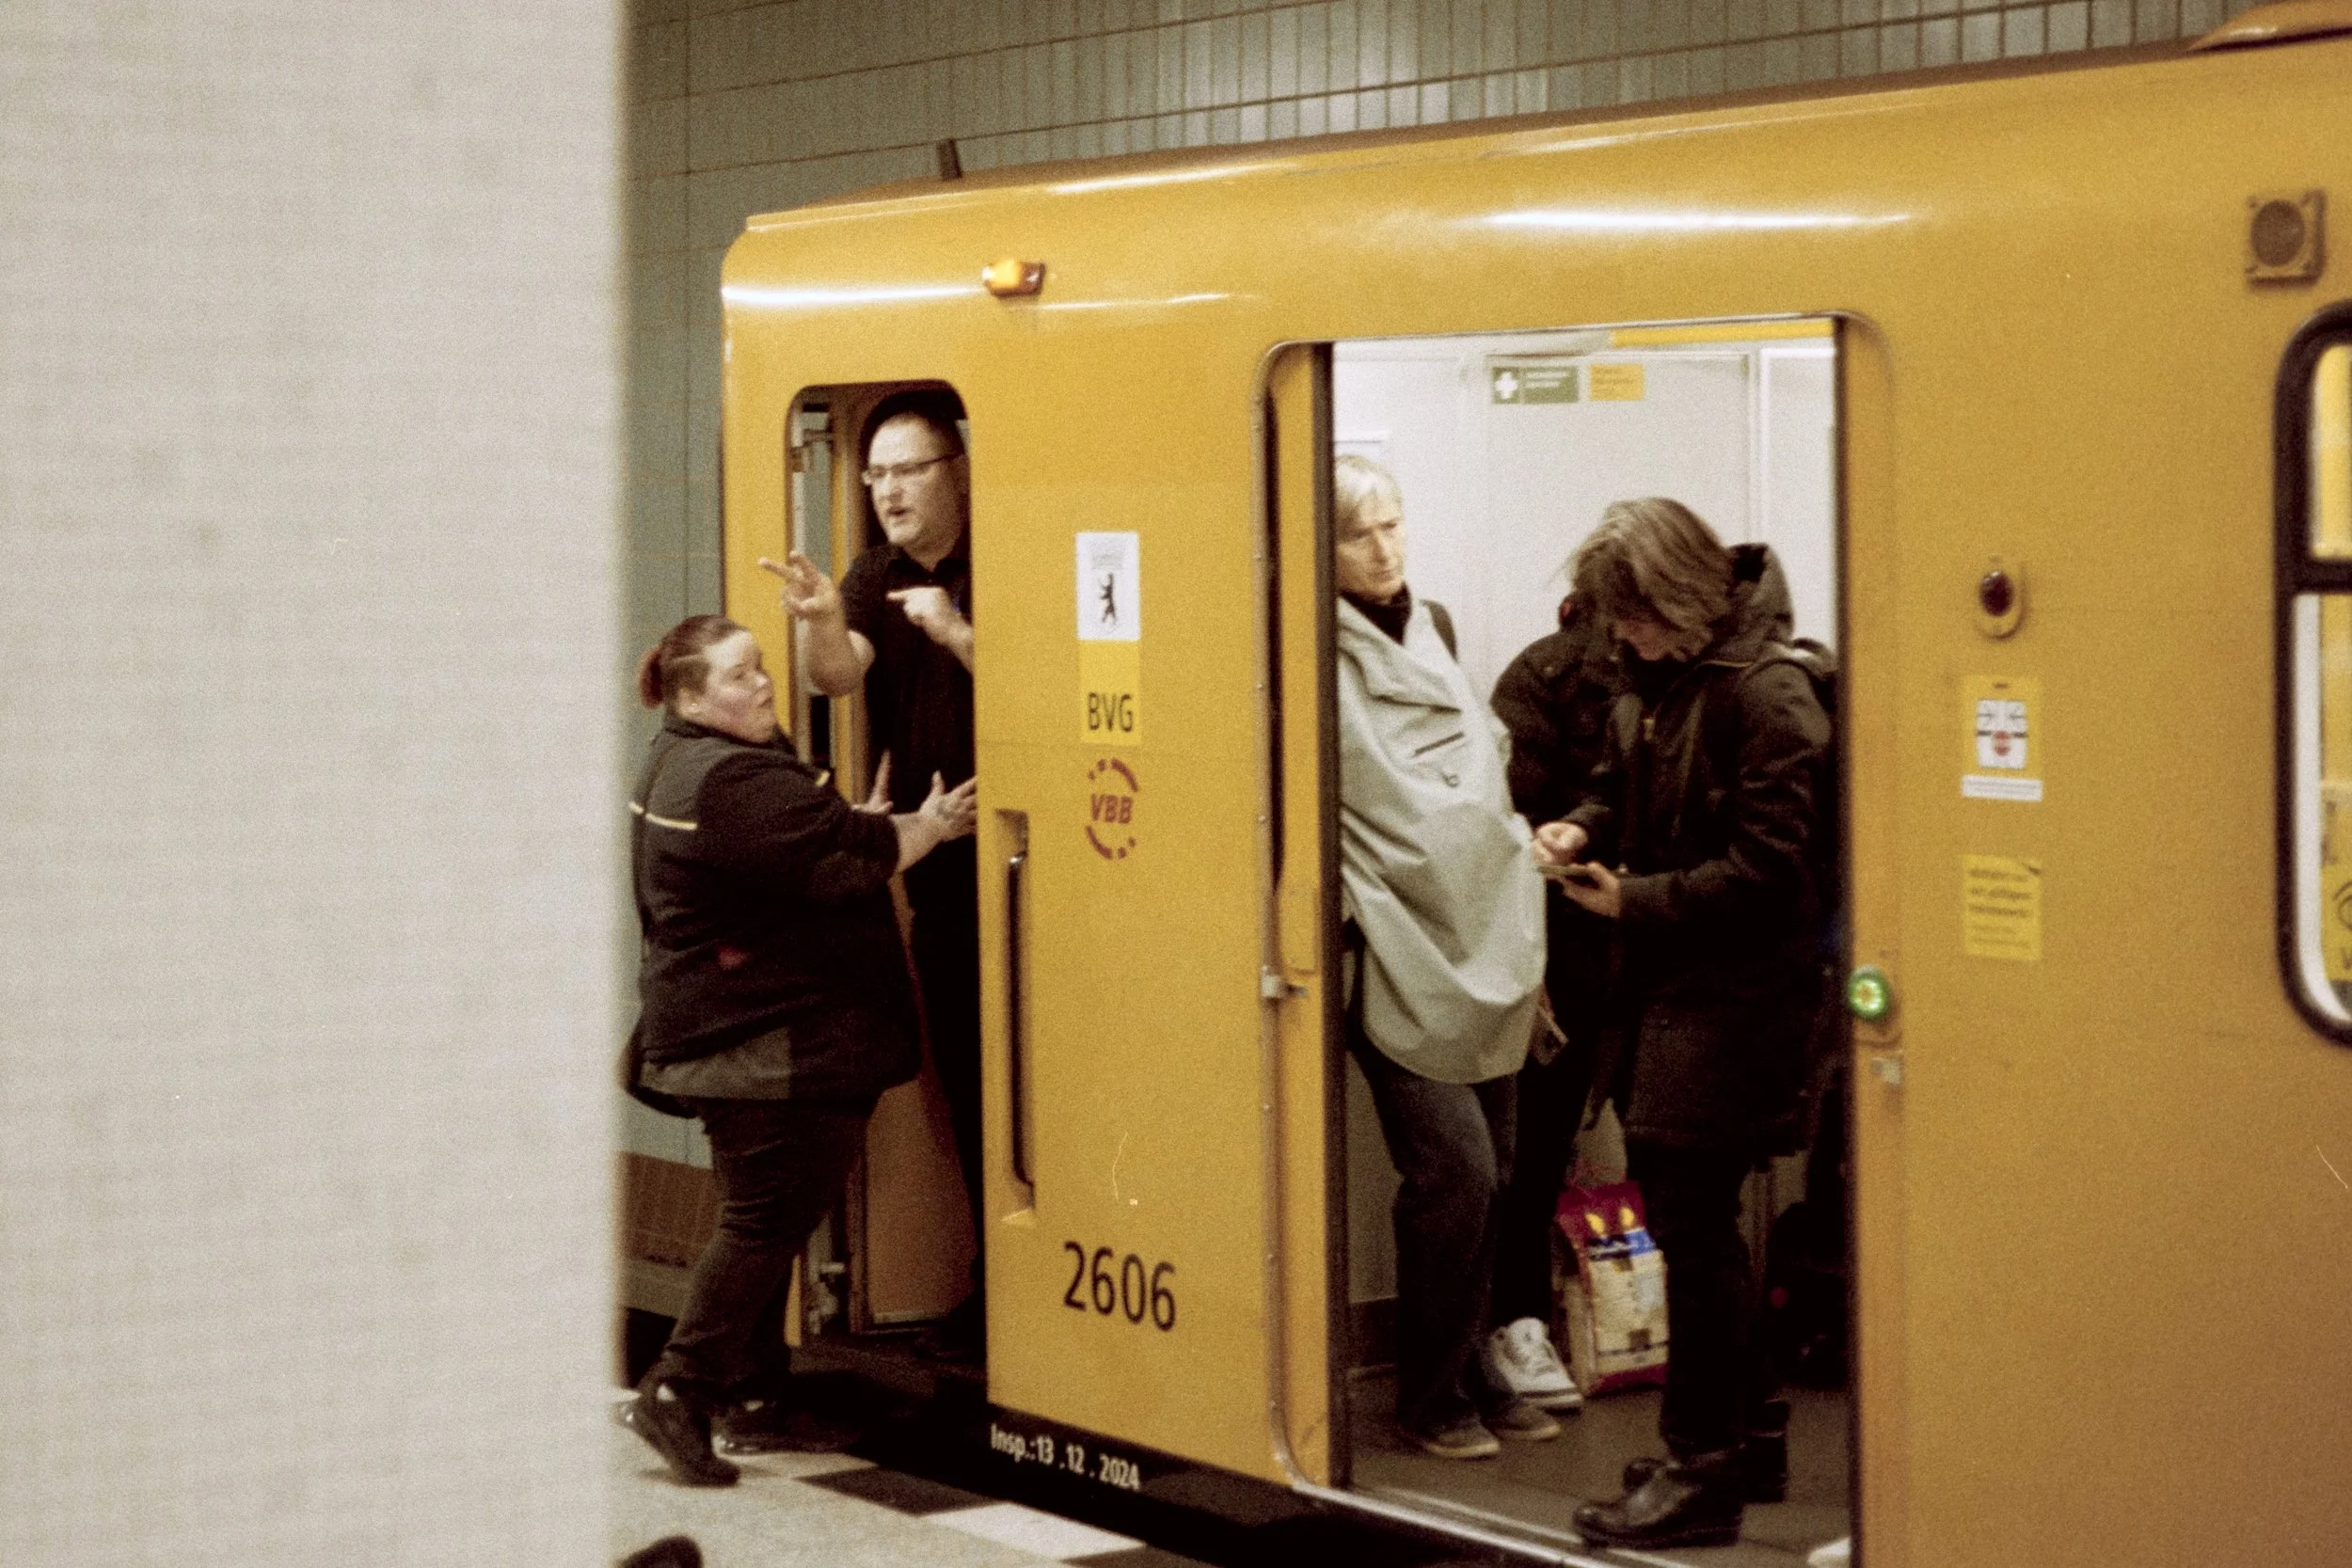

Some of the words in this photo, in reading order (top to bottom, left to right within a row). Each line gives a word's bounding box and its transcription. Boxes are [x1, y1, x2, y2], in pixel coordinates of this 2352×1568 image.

[1087, 691, 1135, 734] BVG
[1089, 792, 1135, 826] VBB
[1063, 1240, 1178, 1334] 2606
[1098, 1452, 1141, 1492] 2024
